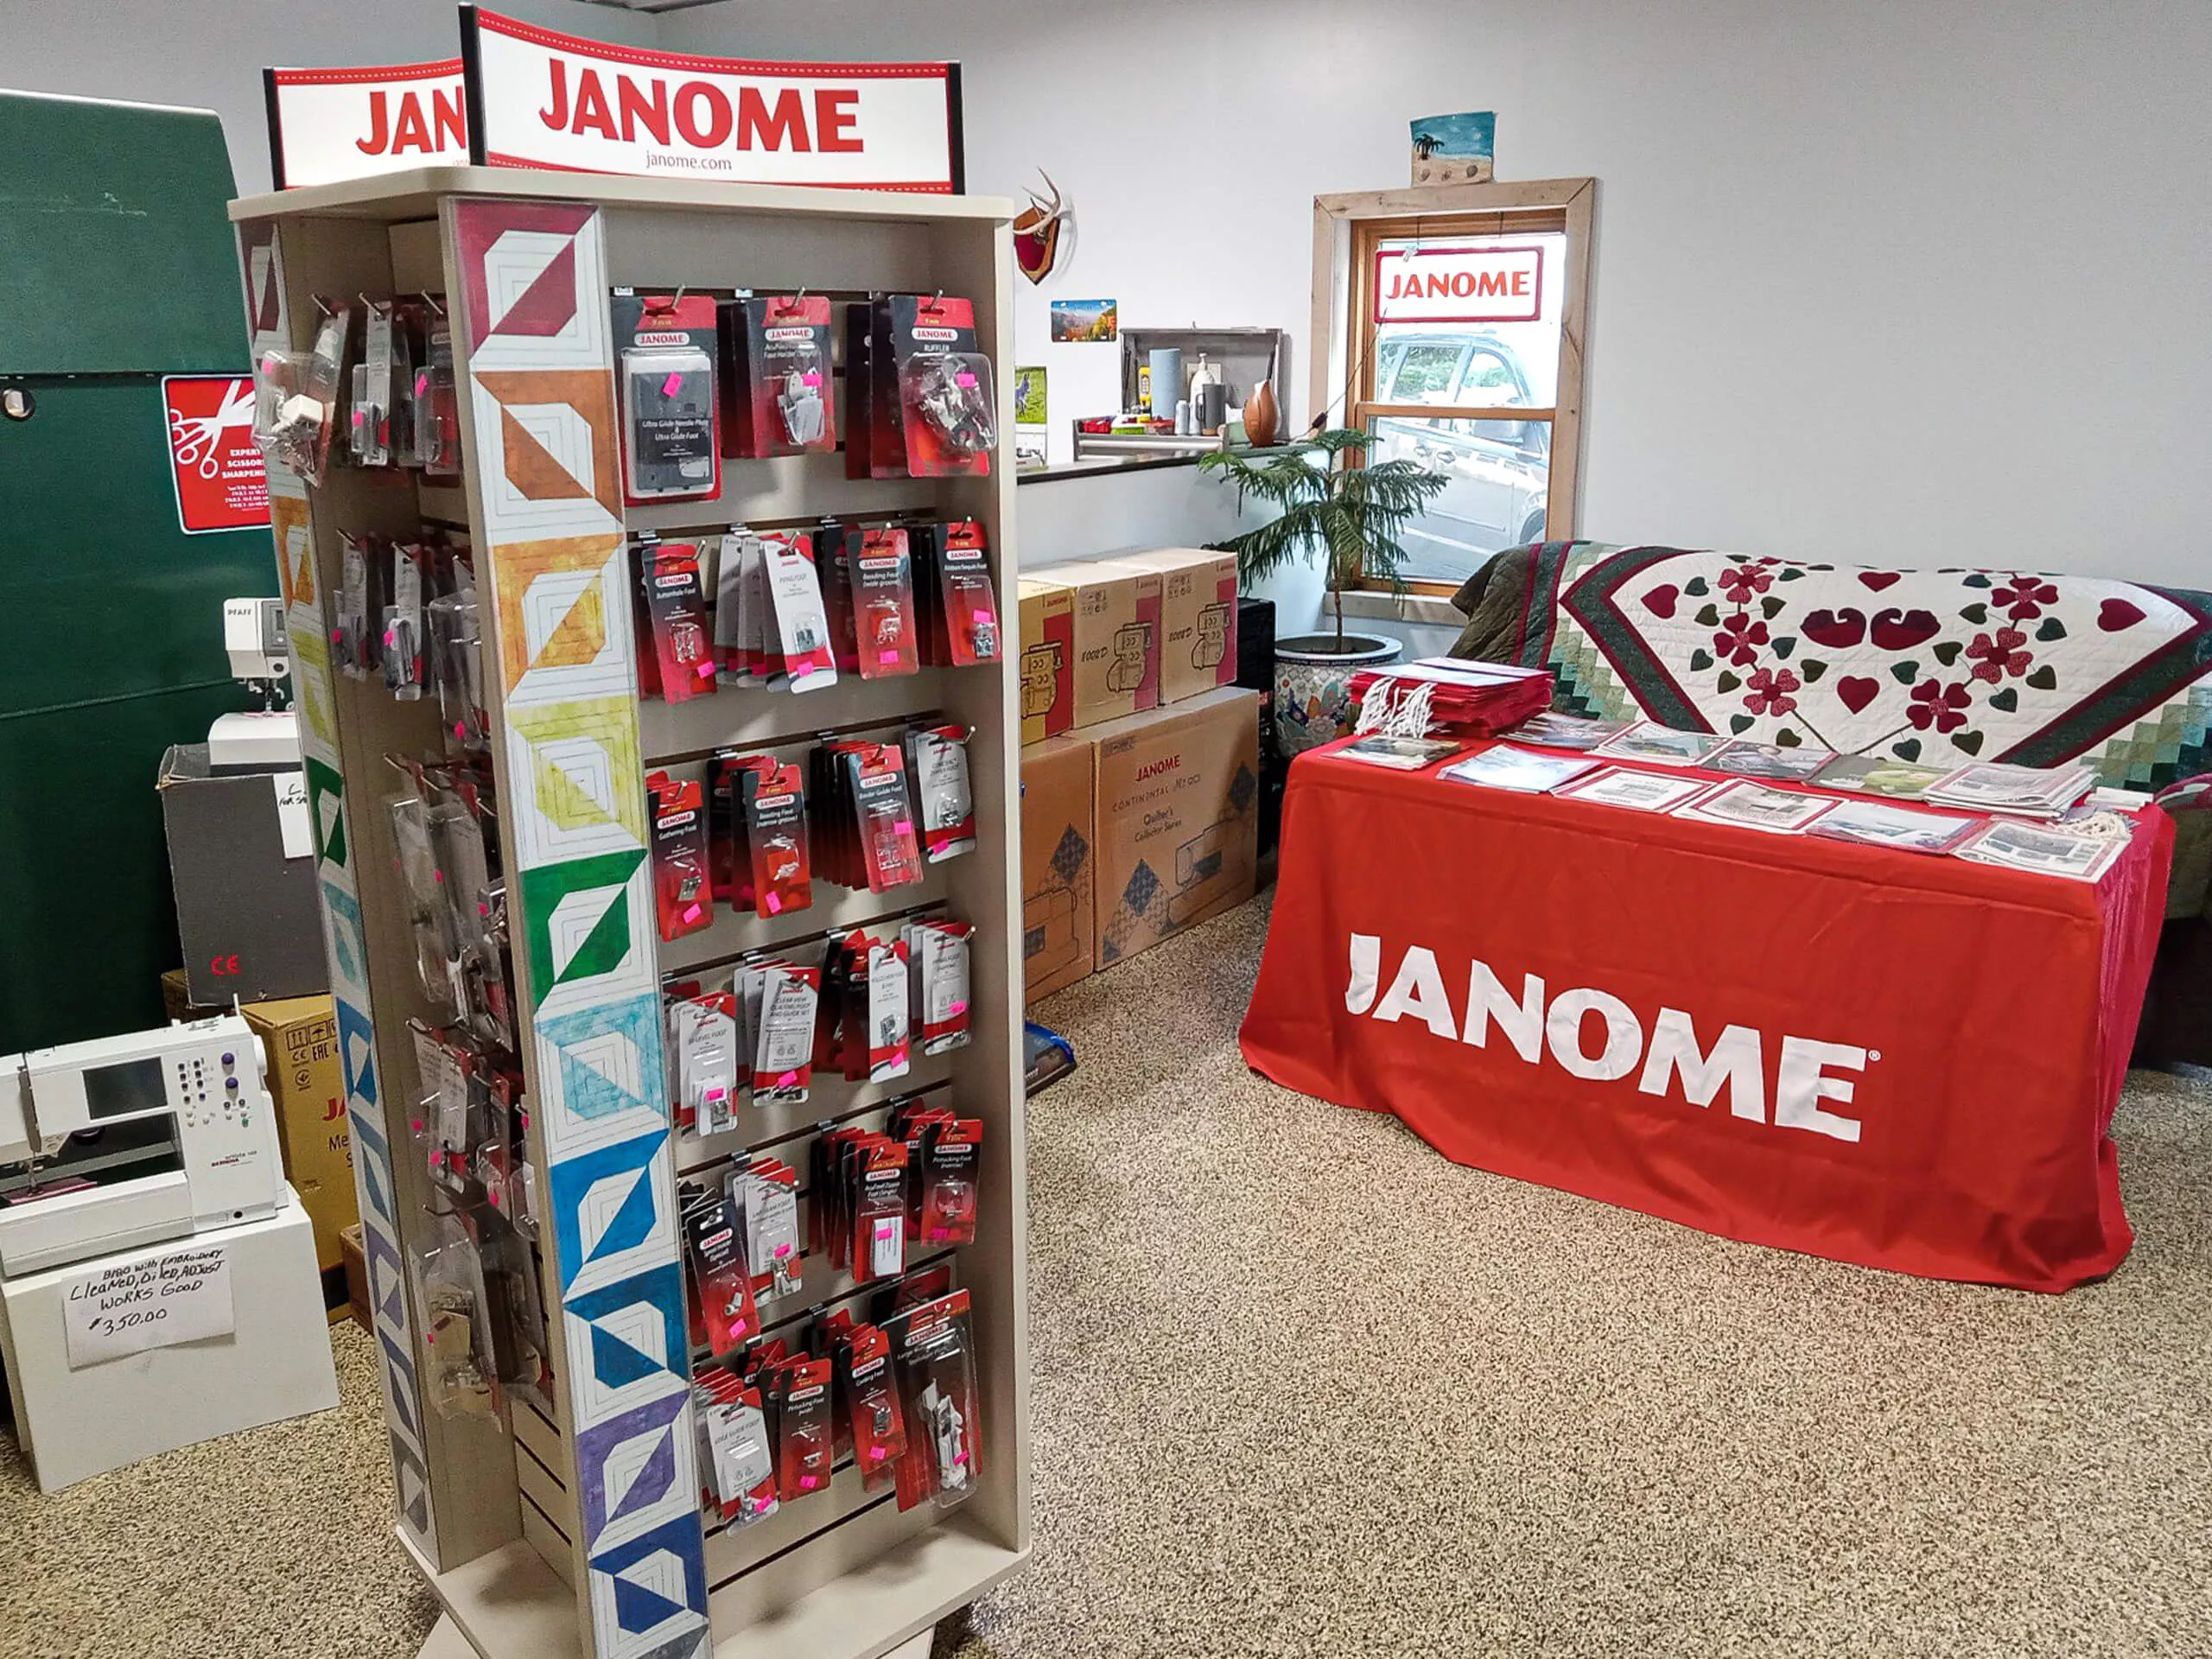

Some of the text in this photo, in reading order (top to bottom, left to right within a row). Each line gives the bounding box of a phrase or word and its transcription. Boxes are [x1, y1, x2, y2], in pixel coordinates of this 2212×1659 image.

[539, 58, 864, 152] JANOME
[355, 85, 466, 156] JAN
[646, 149, 732, 170] janome.com
[1386, 270, 1530, 299] JANOME
[640, 335, 684, 344] JANOME
[660, 575, 689, 585] JANOME
[1136, 754, 1181, 782] JANOME
[865, 775, 893, 785] JANOME
[662, 813, 691, 826] JANOME
[211, 954, 242, 976] CE
[292, 1049, 306, 1062] CE
[703, 1230, 730, 1248] JANOME
[135, 1260, 157, 1273] with
[100, 1281, 203, 1312] WORKS GOOD
[89, 1308, 167, 1337] $350.00
[911, 1325, 943, 1344] JANOME
